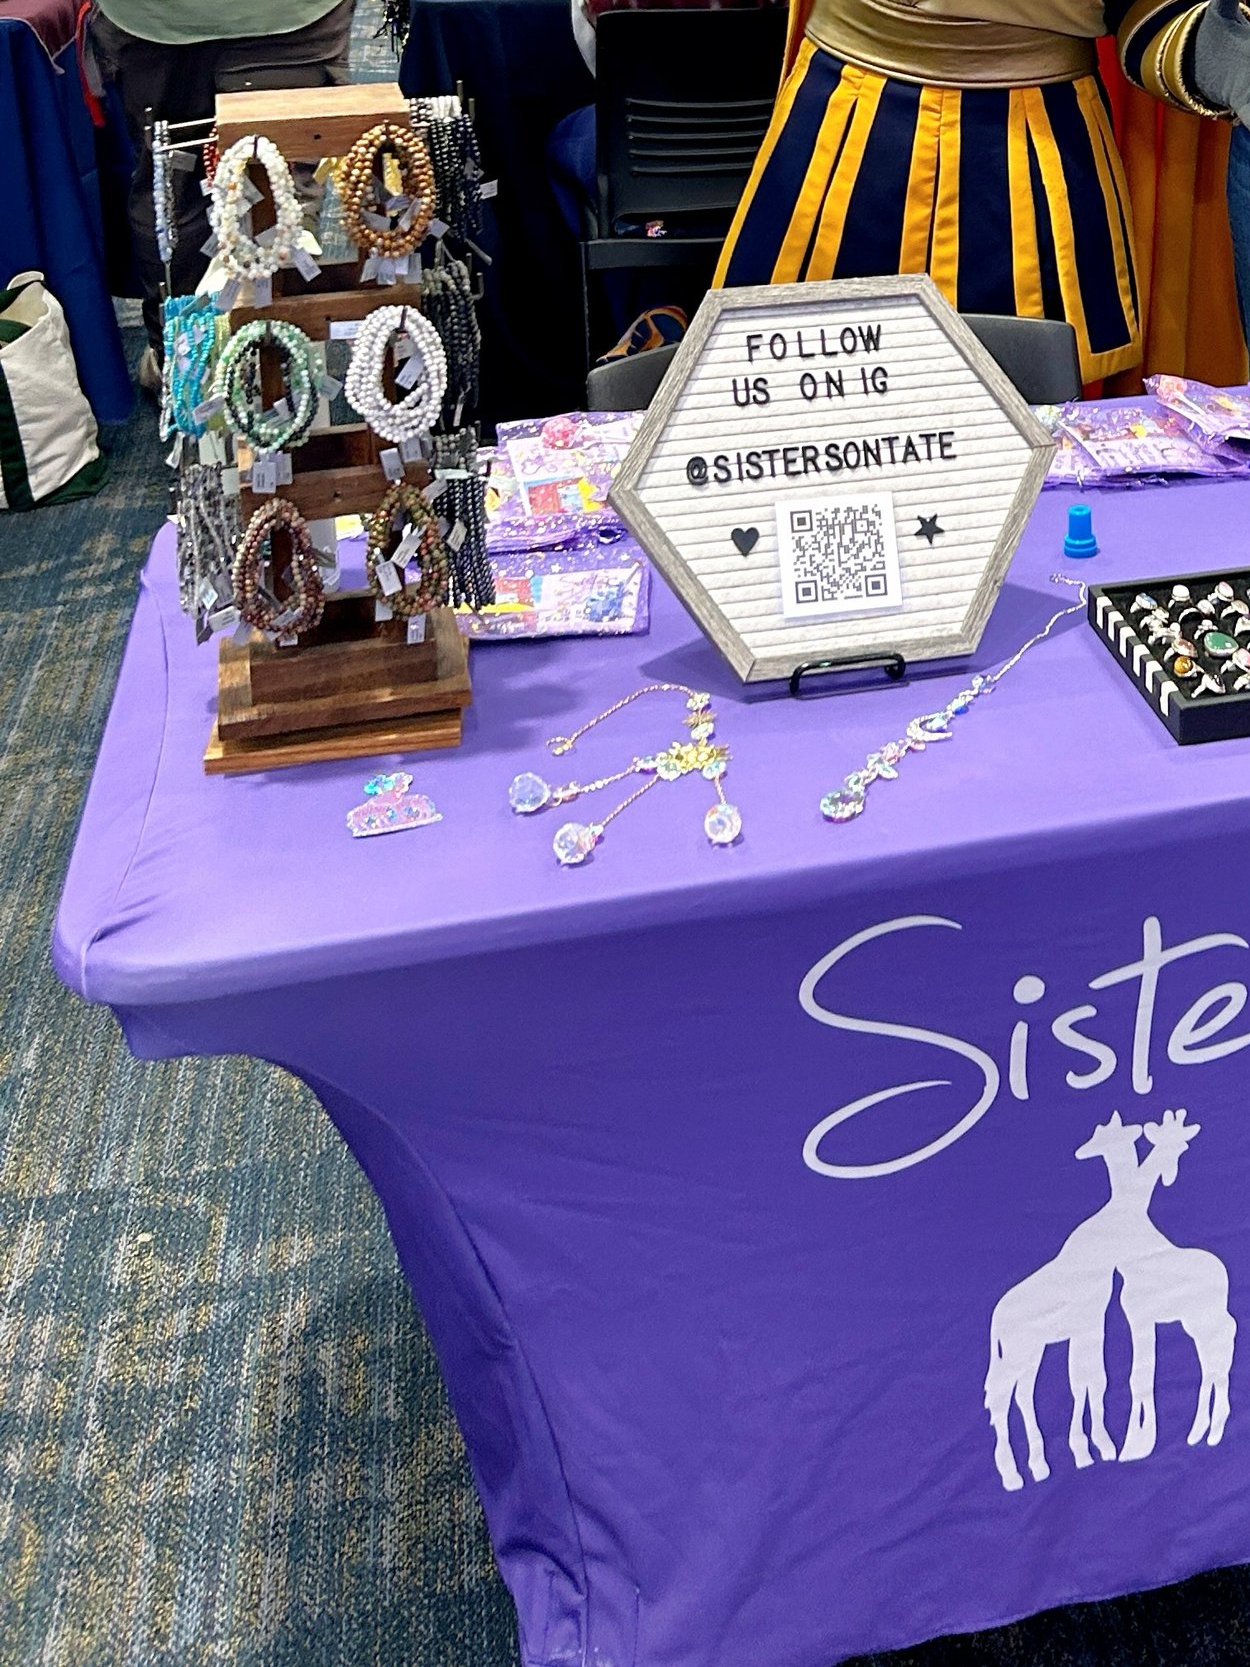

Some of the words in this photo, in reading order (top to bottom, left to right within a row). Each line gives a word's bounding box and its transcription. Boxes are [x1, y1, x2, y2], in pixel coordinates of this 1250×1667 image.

[746, 325, 881, 362] FOLLOW
[732, 377, 770, 407] US
[799, 370, 845, 401] ON
[860, 367, 888, 394] IG
[686, 431, 957, 486] @SISTERSONTATE
